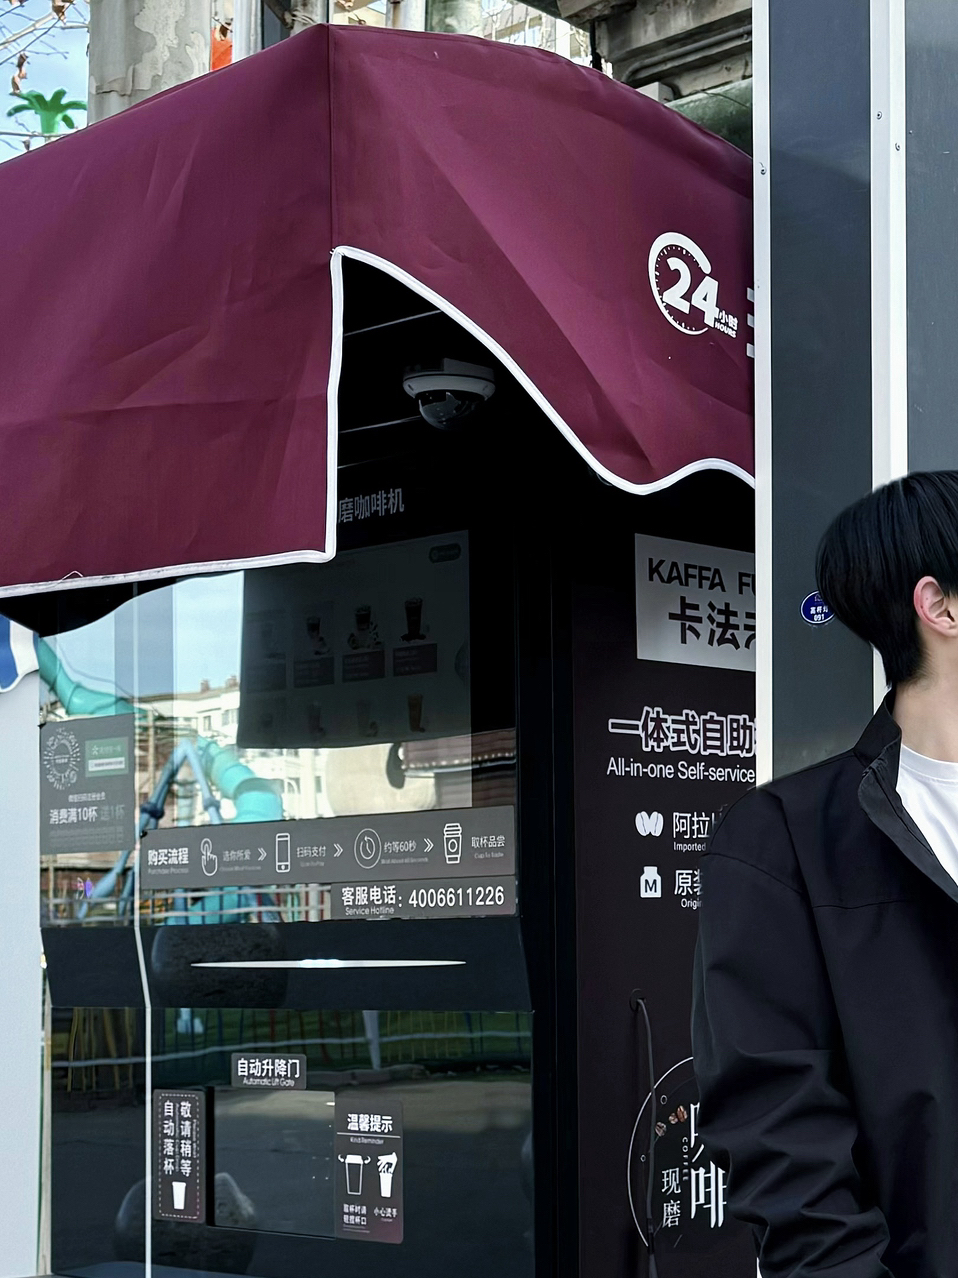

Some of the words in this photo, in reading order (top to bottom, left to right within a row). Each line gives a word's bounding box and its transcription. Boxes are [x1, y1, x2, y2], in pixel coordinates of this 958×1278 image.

[662, 257, 719, 328] 24
[714, 321, 737, 338] HOURS
[719, 310, 738, 330] 小时
[338, 488, 405, 523] 磨咖啡机
[648, 558, 726, 593] KAFFA
[738, 571, 756, 596] F
[608, 706, 757, 757] 一体式自助
[607, 757, 675, 779] All-in-one
[677, 760, 756, 783] Self-service
[673, 811, 716, 839] 阿拉
[296, 846, 327, 858] 扫码支付
[471, 835, 506, 848] 取杯品尝
[673, 841, 707, 853] Imported
[148, 847, 189, 865] 购买流程
[345, 907, 370, 916] Service
[371, 906, 395, 915] Hotline
[237, 1057, 300, 1078] 自动升降门
[347, 1113, 393, 1133] 温馨提示
[163, 1100, 175, 1176] 自动落杯
[180, 1101, 192, 1177] 敬请稍等
[661, 1167, 682, 1228] 现磨
